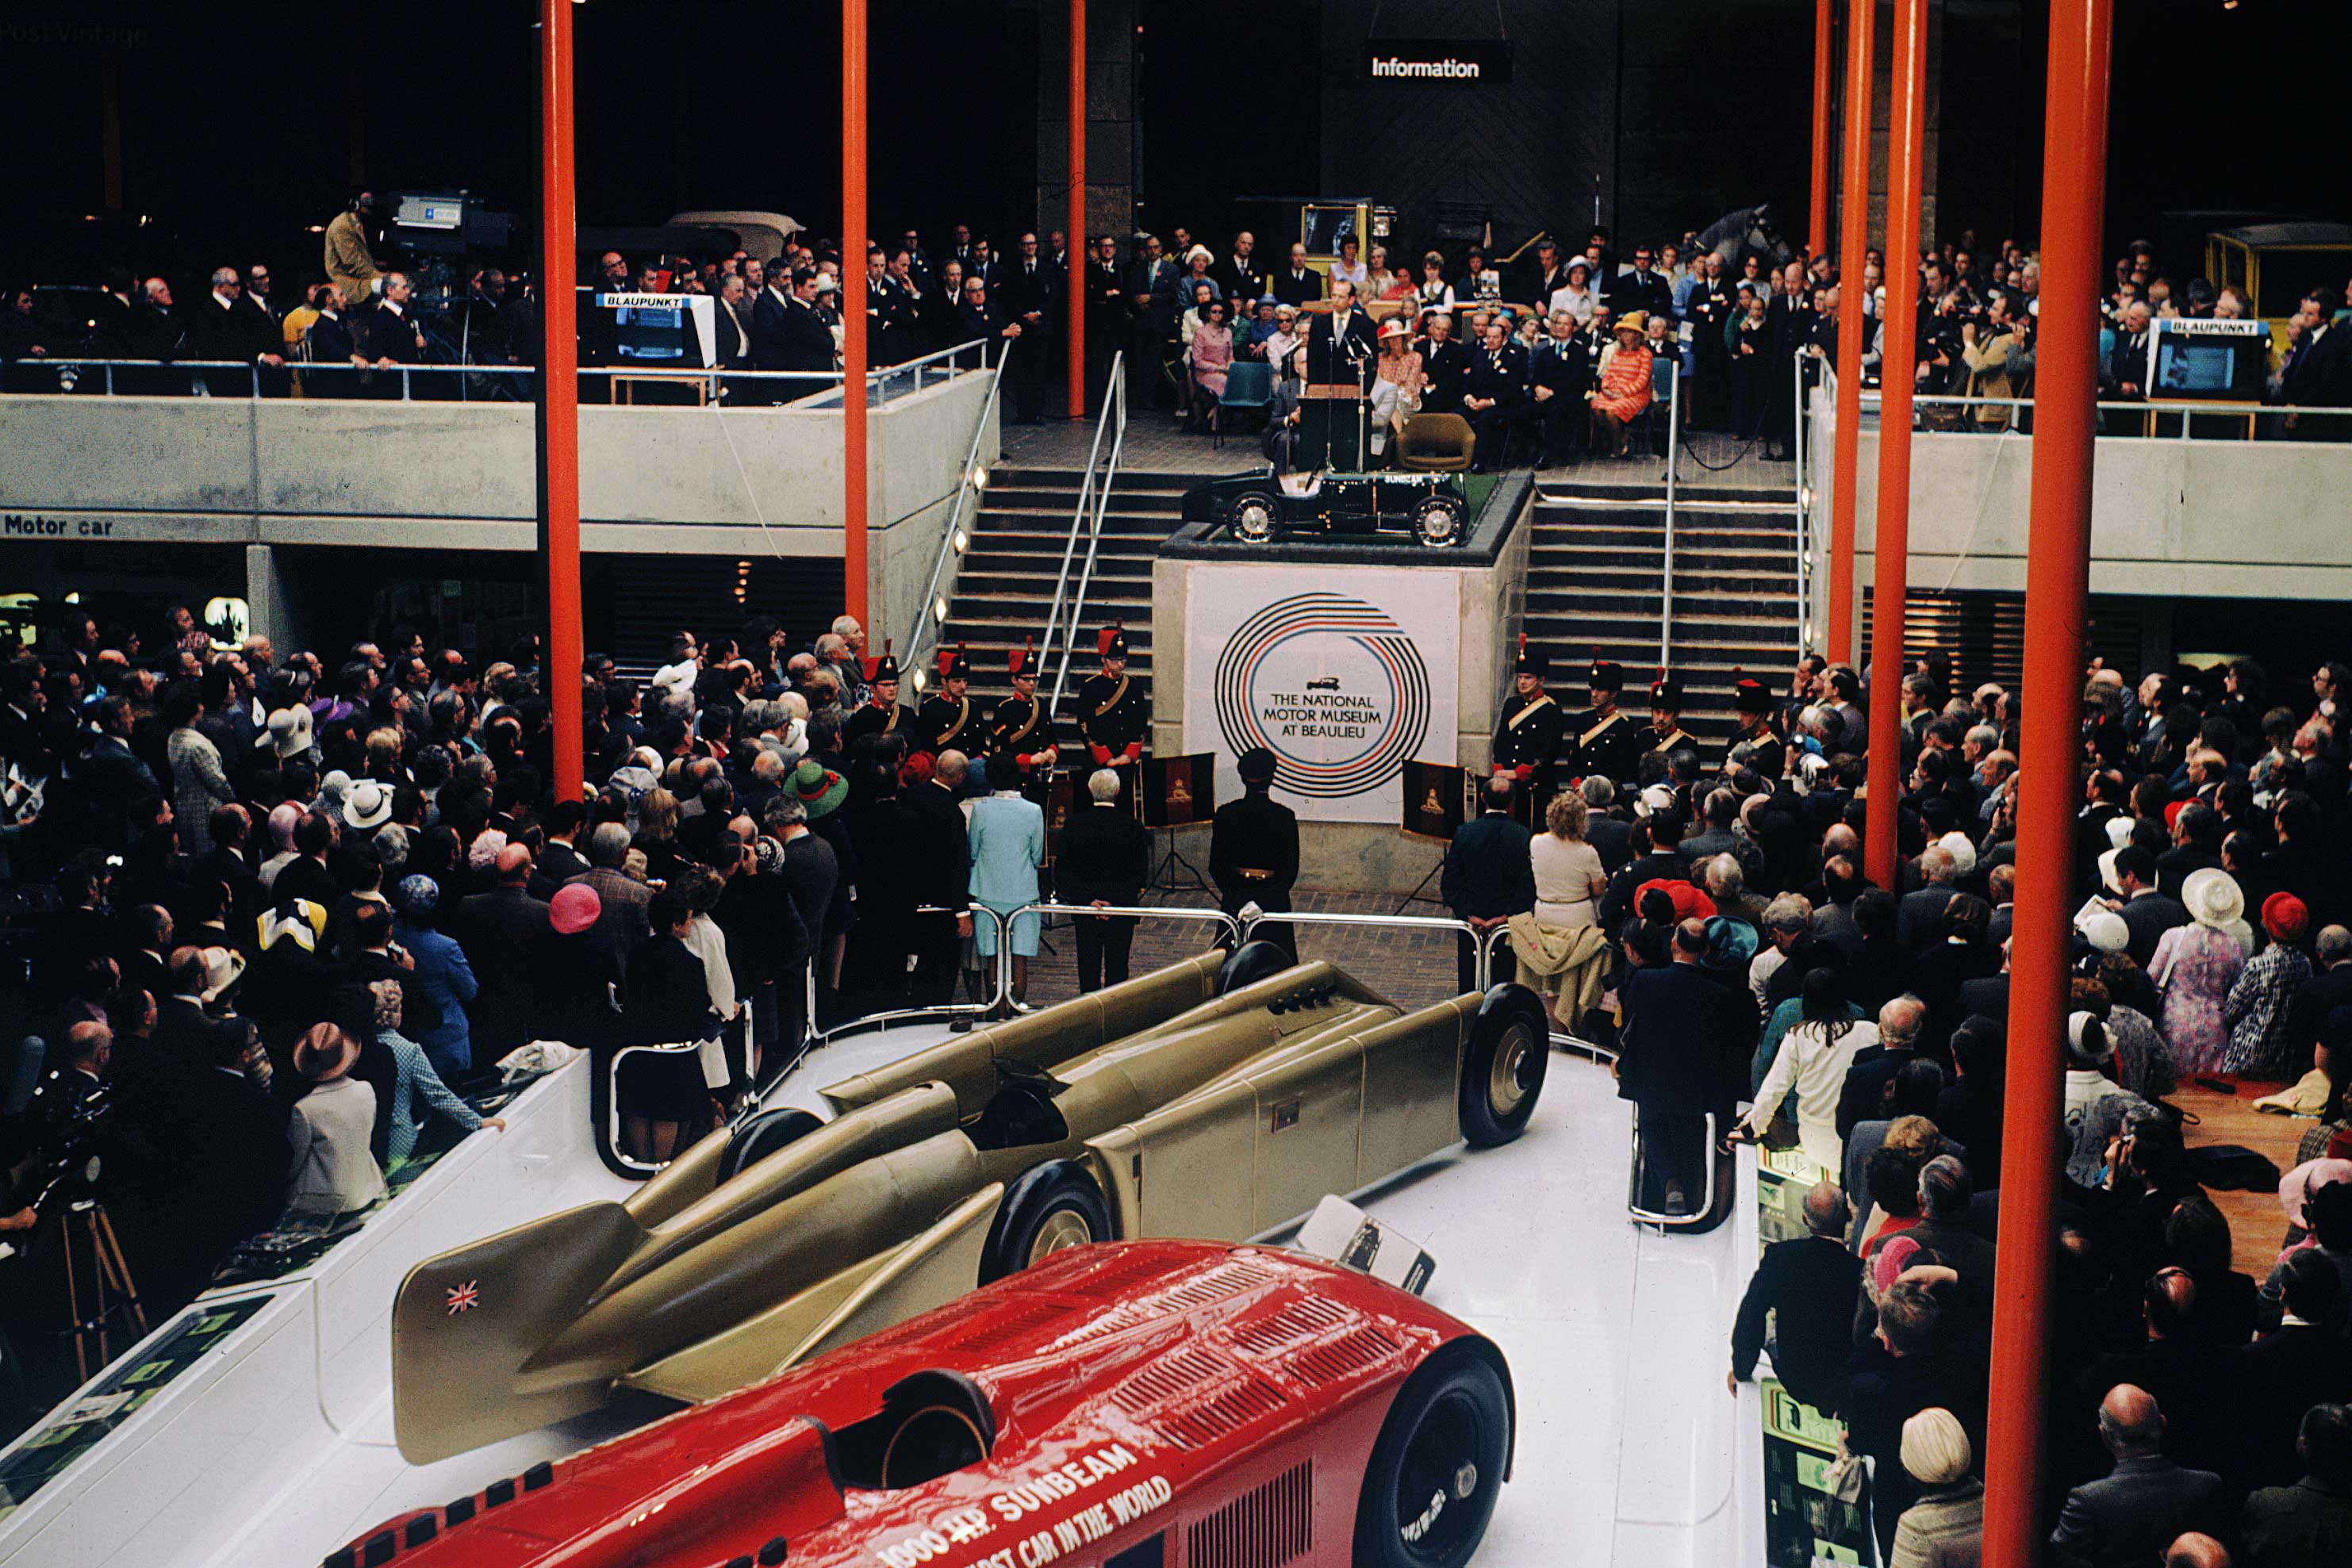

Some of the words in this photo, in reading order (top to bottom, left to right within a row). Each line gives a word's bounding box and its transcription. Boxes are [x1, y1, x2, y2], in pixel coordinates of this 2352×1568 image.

[58, 18, 148, 49] Vintage
[1372, 57, 1479, 78] Information
[608, 296, 681, 307] BLAUPUNKT
[2172, 321, 2255, 333] BLAUPUNKT
[5, 516, 67, 535] Motor
[78, 519, 113, 535] car
[1271, 694, 1298, 705] THE
[1303, 694, 1375, 708] NATIONAL
[1264, 708, 1317, 722] MOTOR
[1320, 710, 1382, 724] MUSEUM
[1282, 724, 1298, 736] AT
[1302, 725, 1365, 738] BEAULIEU
[990, 1443, 1138, 1522] SUNBEAM
[1019, 1531, 1060, 1568] CAR
[1053, 1518, 1081, 1554] IN
[1072, 1502, 1114, 1543] THE
[1107, 1475, 1172, 1526] WORLD
